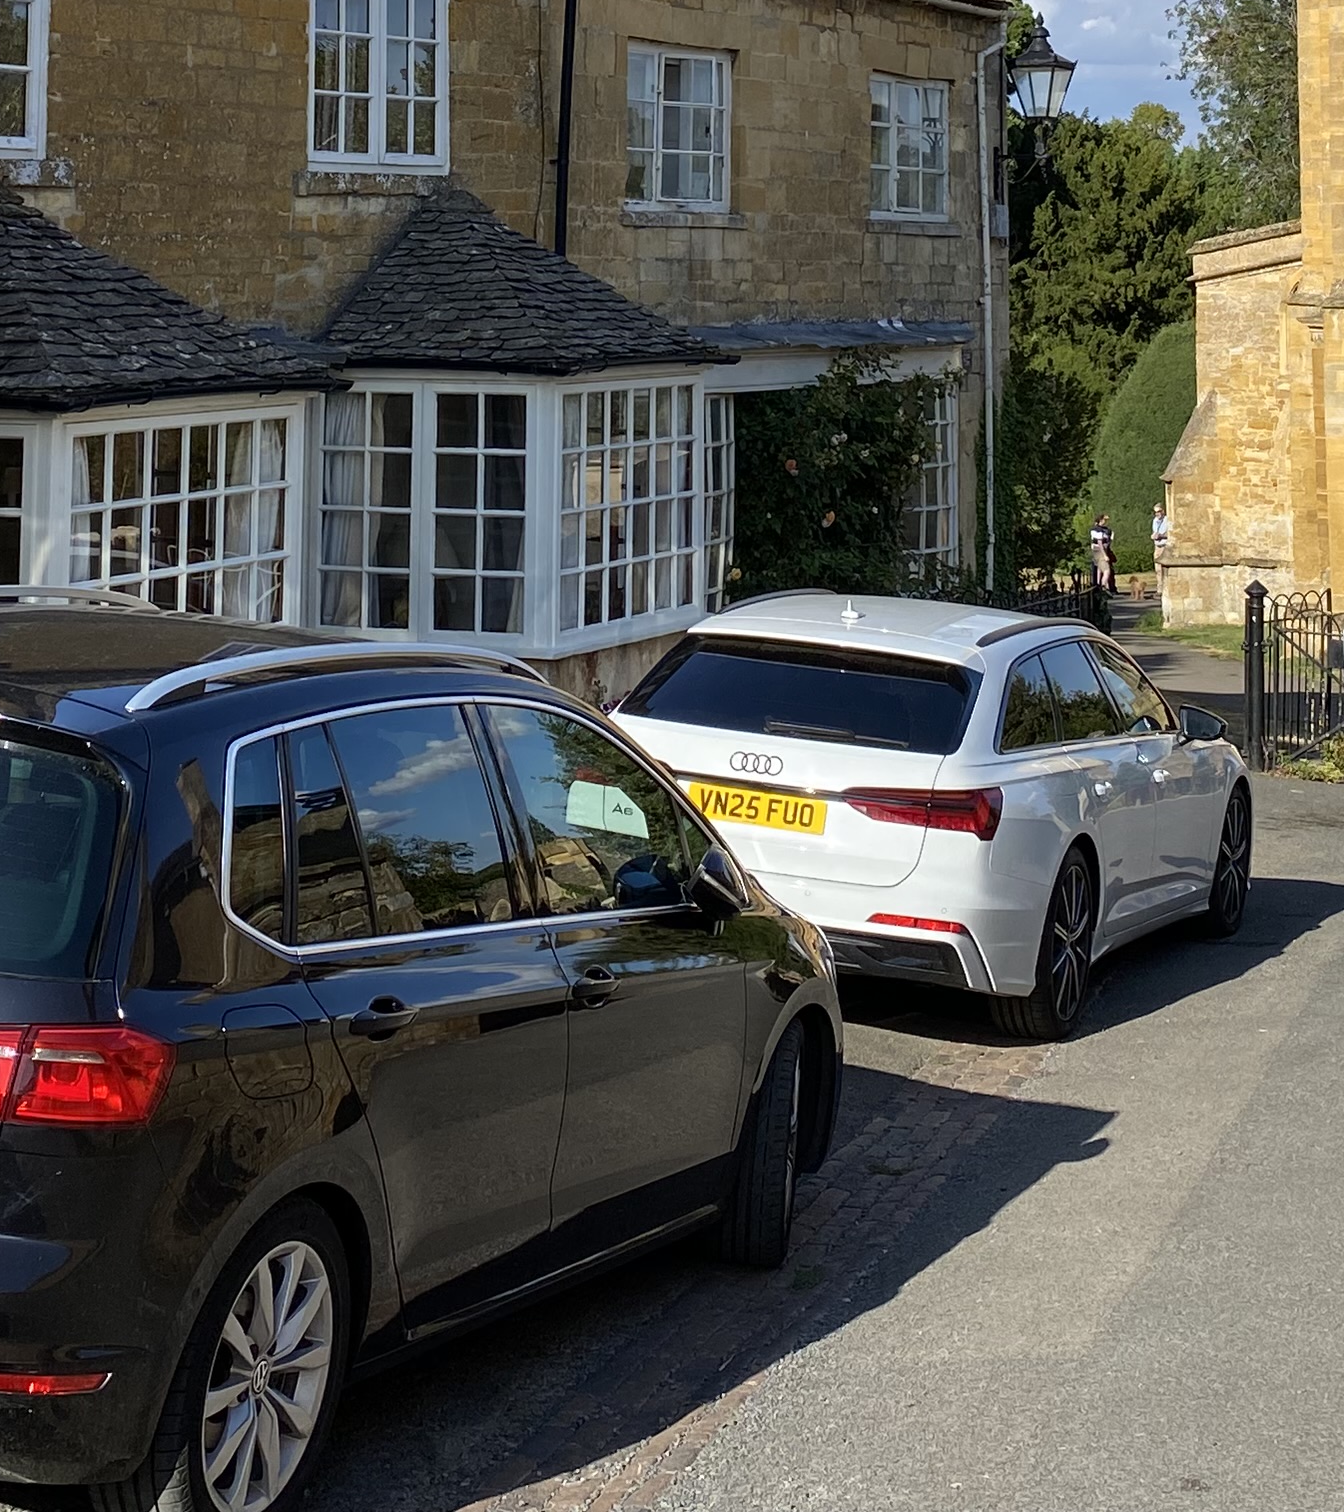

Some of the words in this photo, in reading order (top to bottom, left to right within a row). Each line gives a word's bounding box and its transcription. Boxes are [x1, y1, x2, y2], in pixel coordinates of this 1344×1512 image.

[612, 802, 634, 816] A6
[700, 788, 761, 820] VN25
[766, 798, 815, 827] FUO
